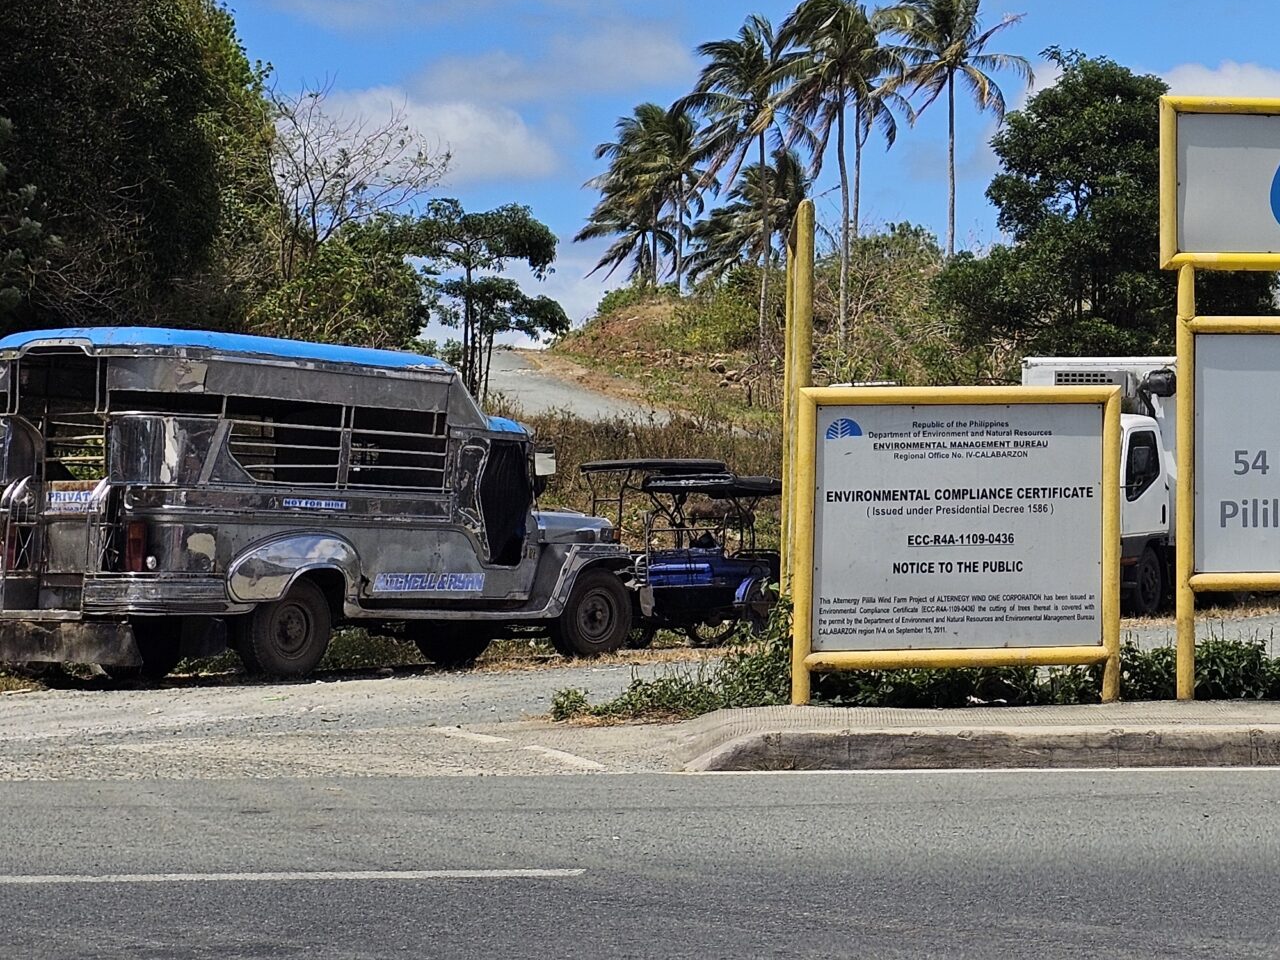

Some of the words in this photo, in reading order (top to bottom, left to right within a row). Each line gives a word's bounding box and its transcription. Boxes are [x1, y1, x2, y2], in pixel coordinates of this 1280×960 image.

[912, 421, 944, 429] Republic
[969, 420, 1009, 429] Philippines
[868, 431, 911, 440] Department
[922, 430, 969, 438] Environment
[1014, 429, 1052, 437] Resources
[873, 442, 947, 450] ENVIRONMENTAL
[1014, 440, 1049, 448] BUREAU
[893, 452, 926, 461] Regional
[1233, 450, 1269, 475] 54
[826, 489, 930, 502] ENVIRONMENTAL
[934, 488, 1013, 500] COMPLIANCE
[1016, 487, 1093, 499] CERTIFICATE
[284, 499, 302, 507] NOT
[305, 500, 322, 508] FOR
[325, 501, 345, 509] HIRE
[906, 506, 933, 515] under
[936, 504, 990, 515] Presidential
[992, 504, 1024, 514] Decree
[907, 533, 1015, 546] ECC-R4A-1109-0436
[893, 562, 935, 574] NOTICE
[938, 562, 953, 573] TO
[956, 561, 979, 573] THE
[982, 561, 1023, 572] PUBLIC
[909, 596, 927, 604] Project
[863, 617, 893, 625] Department
[1044, 614, 1075, 622] Management
[858, 628, 874, 636] region
[896, 627, 923, 635] September
